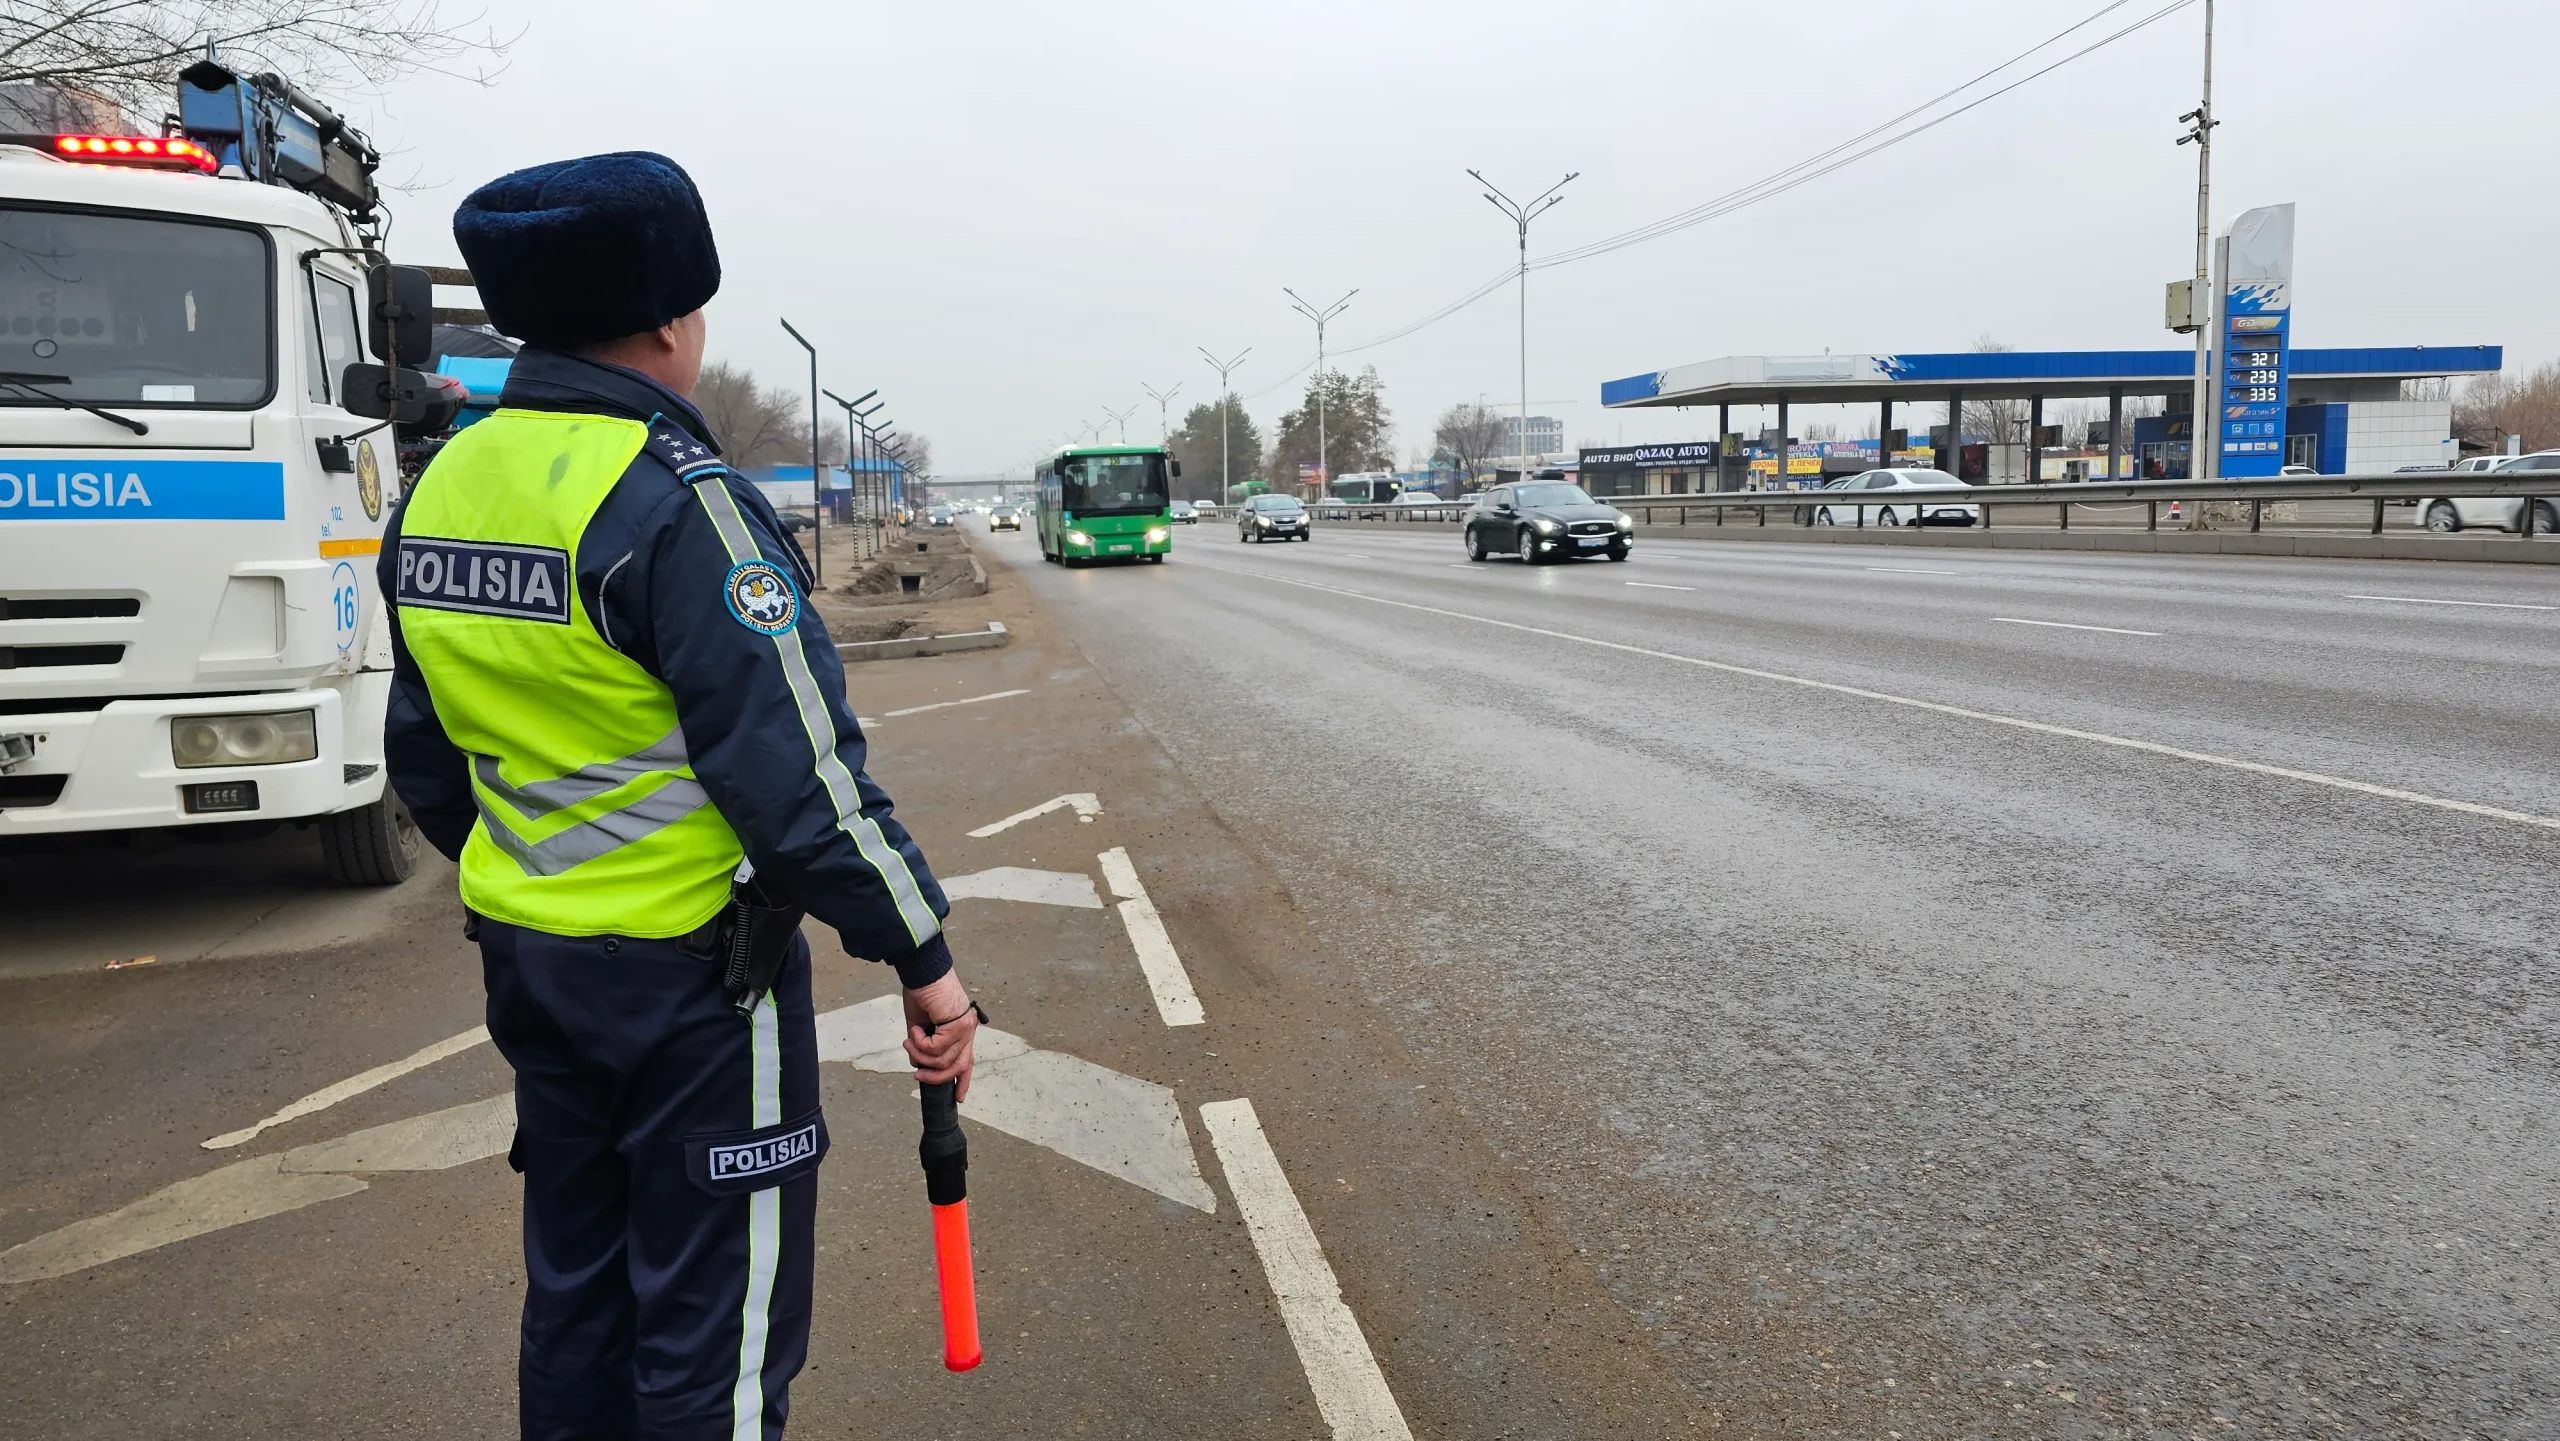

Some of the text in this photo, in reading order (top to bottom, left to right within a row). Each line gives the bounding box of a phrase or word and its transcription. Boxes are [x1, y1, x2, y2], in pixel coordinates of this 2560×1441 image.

[2251, 353, 2279, 366] 321
[2250, 370, 2277, 384] 239
[2249, 388, 2276, 401] 335
[1584, 454, 1611, 464] AUTO
[1635, 445, 1708, 460] QAZAQ AUTO
[1797, 459, 1820, 467] ПЕЧЕК
[321, 523, 332, 537] tel.
[400, 550, 558, 608] POLISIA
[728, 564, 774, 592] ALMATY QALASY
[333, 585, 355, 631] 16
[740, 613, 769, 631] POLISIA
[718, 1133, 810, 1173] POLISIA
